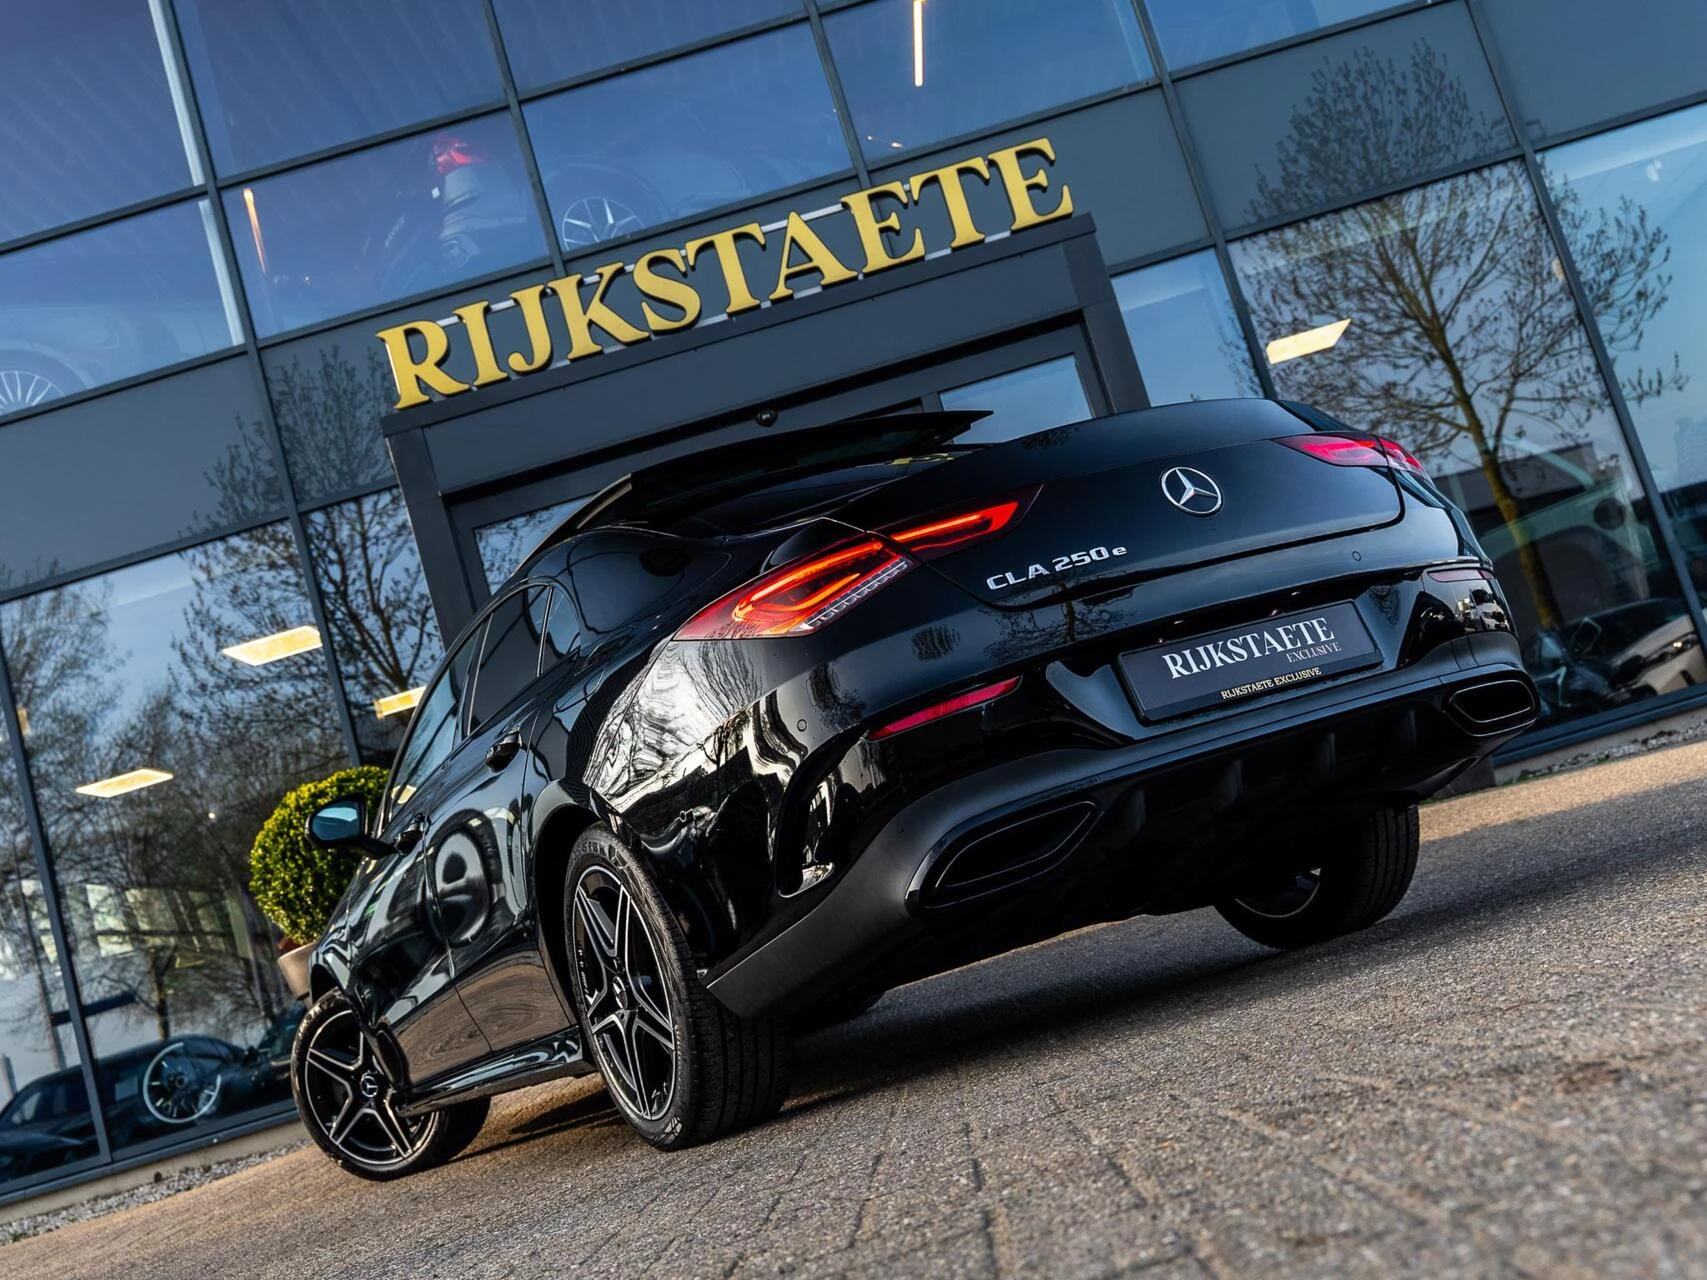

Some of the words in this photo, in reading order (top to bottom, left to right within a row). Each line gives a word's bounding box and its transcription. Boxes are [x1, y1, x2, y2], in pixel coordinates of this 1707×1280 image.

[375, 137, 1074, 409] RIJKSTAETE
[986, 563, 1050, 590] CLA
[1162, 617, 1335, 679] RIJKSTAETE
[1286, 642, 1342, 663] EXCLUSIVE
[1221, 679, 1275, 700] RIJKSTAETE
[1275, 667, 1322, 686] EXCLUSIVE
